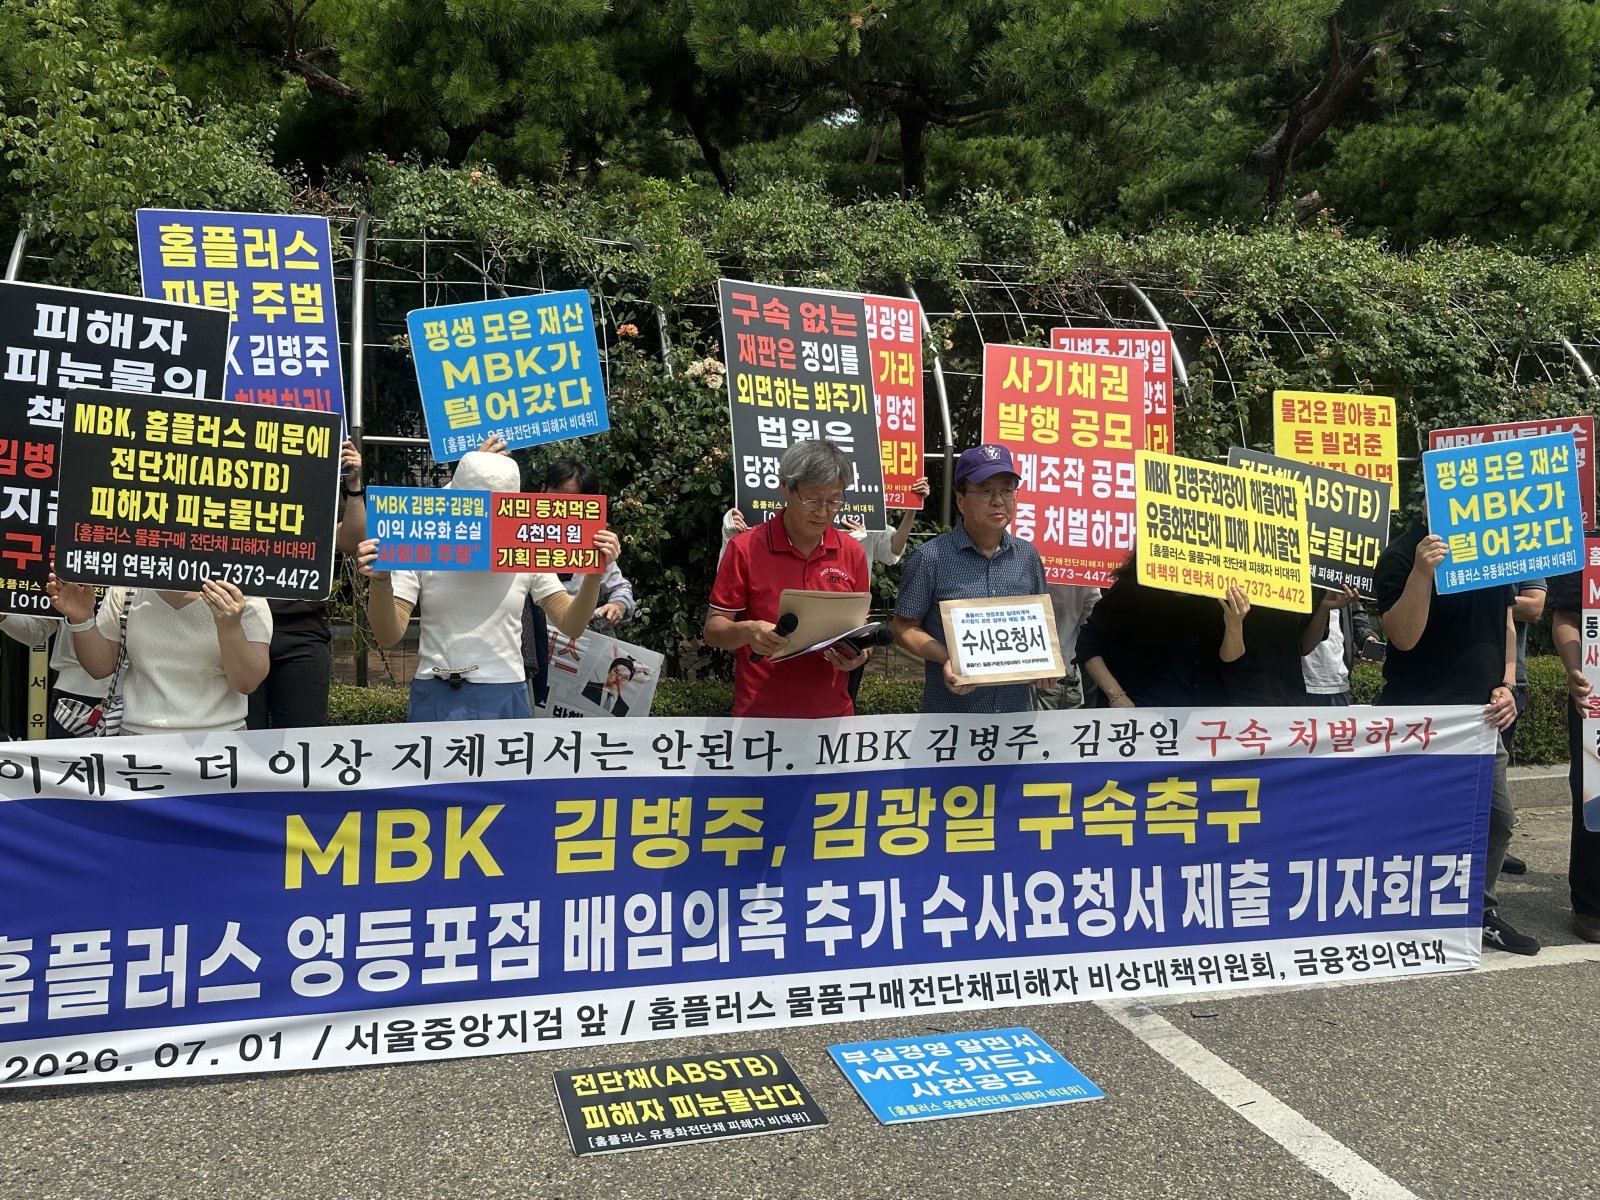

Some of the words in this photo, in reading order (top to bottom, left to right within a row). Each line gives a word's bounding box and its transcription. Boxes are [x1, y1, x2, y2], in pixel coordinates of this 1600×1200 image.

[159, 223, 319, 270] 홈플러스
[252, 282, 324, 323] 주범
[732, 292, 790, 331] 구속
[800, 302, 857, 337] 없는
[33, 302, 188, 355] 피해자
[423, 316, 476, 352] 평생
[483, 310, 532, 344] 모은
[537, 302, 585, 335] 재산
[4, 346, 207, 399] 피눈물의
[250, 335, 330, 376] 김병주
[442, 341, 582, 389] MBK가
[737, 334, 797, 370] 재판은
[801, 341, 859, 376] 정의를
[879, 351, 915, 386] 가라
[737, 373, 810, 410] 외면하는
[815, 382, 868, 414] 봐주기
[1002, 356, 1129, 402] 사기채권
[444, 377, 592, 430] 털어갔다
[542, 416, 568, 434] 피해자
[569, 410, 598, 430] 비대위]
[886, 396, 916, 431] 망친
[1282, 399, 1328, 424] 물건은
[1332, 401, 1391, 427] 팔아놓고
[74, 403, 136, 440] MBK,
[146, 410, 246, 450] 홈플러스
[255, 420, 330, 458] 때문에
[999, 402, 1060, 442] 발행
[1071, 410, 1133, 449] 공모
[1294, 430, 1314, 454] 돈
[1322, 432, 1382, 457] 빌려준
[1436, 433, 1484, 450] MBK
[110, 447, 290, 494] 전단채(ABSTB)
[1010, 453, 1084, 497] 계조작
[1092, 460, 1135, 499] 공모
[1436, 457, 1478, 490] 평생
[1485, 452, 1524, 483] 모은
[1530, 446, 1569, 475] 재산
[370, 494, 407, 514] "MBK
[498, 498, 532, 517] 서민
[535, 500, 600, 519] 등쳐먹은
[1145, 458, 1171, 495] MBK
[1174, 465, 1248, 511] 김병주회장이
[1250, 478, 1297, 521] 해결하라
[1449, 481, 1565, 526] MBK가
[90, 487, 168, 524] 피해자
[176, 494, 304, 535] 피눈물난다
[377, 519, 405, 539] 이익
[409, 520, 451, 540] 사유화
[455, 521, 481, 540] 손실
[1006, 502, 1036, 542] 중
[1043, 506, 1135, 551] 처벌하라
[74, 523, 131, 544] [홈플러스
[135, 528, 186, 550] 물품구매
[190, 534, 228, 553] 전단채
[232, 538, 270, 556] 피해자
[273, 540, 315, 560] 비대위]
[378, 544, 431, 562] 사회화
[438, 545, 481, 563] 주범"
[517, 524, 562, 543] 4천억
[567, 525, 582, 543] 원
[1146, 502, 1221, 550] 유동화전단채
[1226, 516, 1248, 556] 피해
[1254, 521, 1301, 564] 사재출연
[1307, 522, 1380, 569] 눈물난다
[1449, 517, 1573, 564] 털어갔다
[66, 550, 117, 578] 대책위
[122, 553, 173, 580] 연락처
[178, 560, 320, 590] 010-7373-4472
[498, 548, 530, 567] 기획
[535, 549, 599, 568] 금융사기
[1150, 543, 1186, 561] [홈플러스
[1188, 550, 1220, 566] 물품구매
[1223, 556, 1247, 572] 전단채
[1249, 562, 1272, 576] 피해자
[1274, 566, 1300, 582] 비대위]
[1446, 569, 1480, 587] [홈플러스
[1482, 560, 1527, 579] 유동화전단채
[1528, 556, 1550, 570] 피해자
[1552, 550, 1576, 566] 비대위]
[1146, 562, 1179, 584] 대책위
[1182, 569, 1214, 589] 연락처
[1217, 574, 1305, 604] 010-7373-4472
[1318, 567, 1343, 584] 피해자
[1345, 574, 1372, 592] 비대위]
[962, 625, 1046, 655] 수사요청서
[0, 752, 172, 796] 이제는
[196, 745, 237, 789] 더
[268, 739, 372, 789] 이상
[392, 731, 634, 780] 지체되서는
[652, 730, 794, 772] 안된다.
[816, 729, 912, 761] MBK
[927, 724, 1050, 763] 김병주,
[1070, 719, 1180, 759] 김광일
[1196, 718, 1272, 757] 구속
[1288, 717, 1438, 754] 처벌하자
[284, 804, 505, 890] MBK
[554, 797, 786, 874] 김병주,
[813, 784, 996, 860] 김광일
[1019, 776, 1261, 850] 구속촉구
[0, 921, 262, 1025] 홈플러스
[287, 899, 540, 997] 영등포점
[564, 883, 787, 973] 배임의혹
[805, 878, 907, 956] 추가
[922, 865, 1165, 948] 수사요청서
[1181, 859, 1271, 929] 제출
[1288, 853, 1472, 922] 기자회견
[5, 1048, 133, 1081] 2026.
[154, 1040, 218, 1068] 07.
[238, 1031, 282, 1062] 01
[312, 1025, 332, 1060] /
[346, 1006, 562, 1056] 서울중앙지검
[576, 1002, 608, 1037] 앞
[620, 999, 636, 1035] /
[648, 990, 776, 1031] 홈플러스
[788, 965, 1078, 1019] 물품구매전단채피해자
[1088, 951, 1286, 997] 비상대책위원회,
[1294, 939, 1446, 977] 금융정의연대
[842, 1042, 952, 1065] 부실경영
[955, 1033, 1039, 1054] 알면서
[572, 1054, 778, 1097] 전단채(ABSTB)
[912, 1070, 1043, 1098] 사전공모
[581, 1098, 664, 1130] 피해자
[668, 1084, 805, 1119] 피눈물난다
[888, 1103, 942, 1117] [홈플러스
[944, 1093, 1011, 1110] 유동화전단채
[1012, 1089, 1047, 1103] 피해자
[1048, 1085, 1087, 1098] 비대위]
[588, 1131, 647, 1149] [홈플러스
[650, 1122, 726, 1141] 유동화전단채
[729, 1117, 765, 1132] 피해자
[768, 1111, 811, 1126] 비대위]
